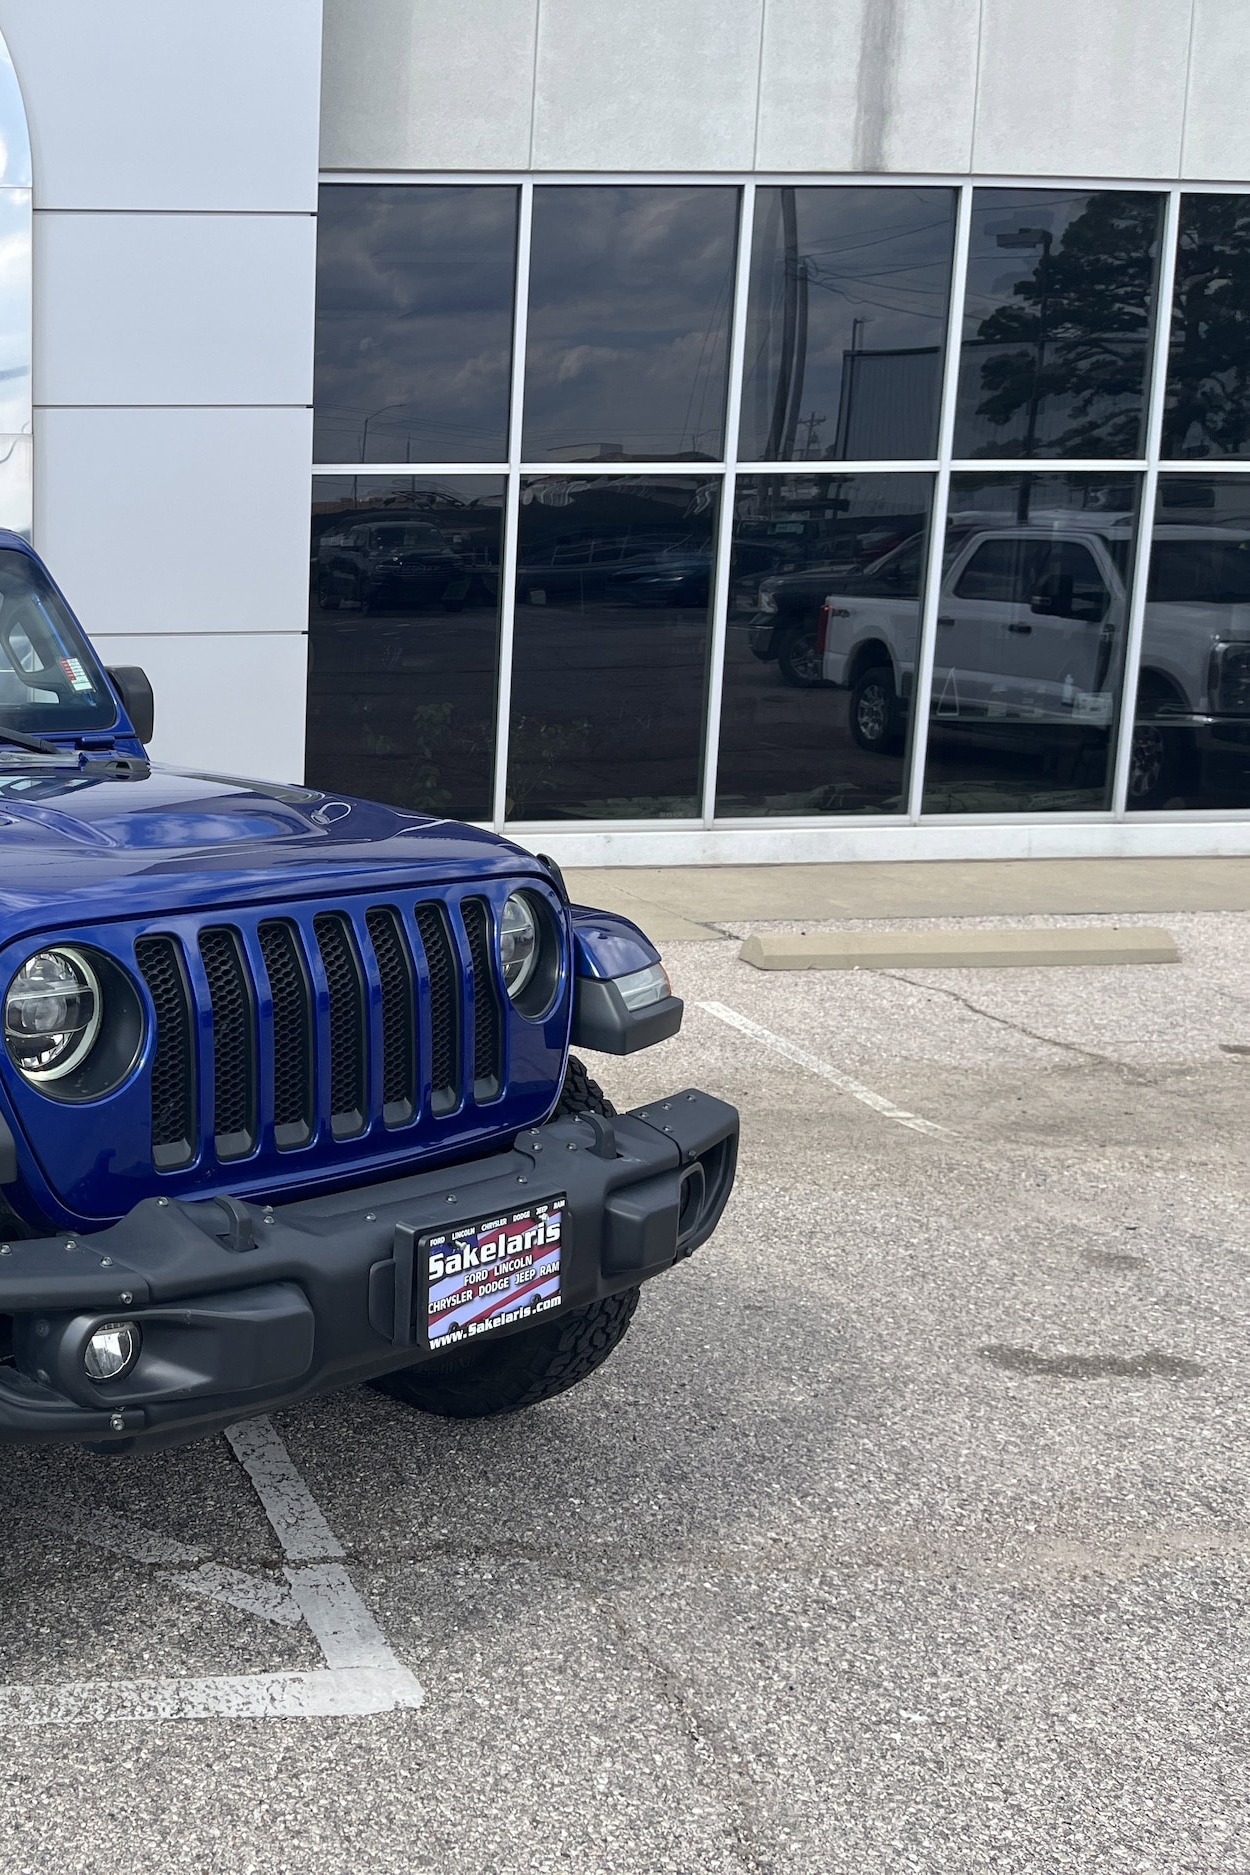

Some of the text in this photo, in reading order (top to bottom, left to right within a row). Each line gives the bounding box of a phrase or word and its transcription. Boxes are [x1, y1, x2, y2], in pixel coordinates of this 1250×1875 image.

[430, 1200, 565, 1247] FORD LINCOLN CHRYSLER DODGE JEEP RAM
[428, 1221, 561, 1281] Sakelaris
[464, 1254, 533, 1286] FORD LINCOLN
[428, 1261, 560, 1314] CHRYSLER DODGE JEEP RAM
[429, 1295, 562, 1350] www.Sakelaris.com
